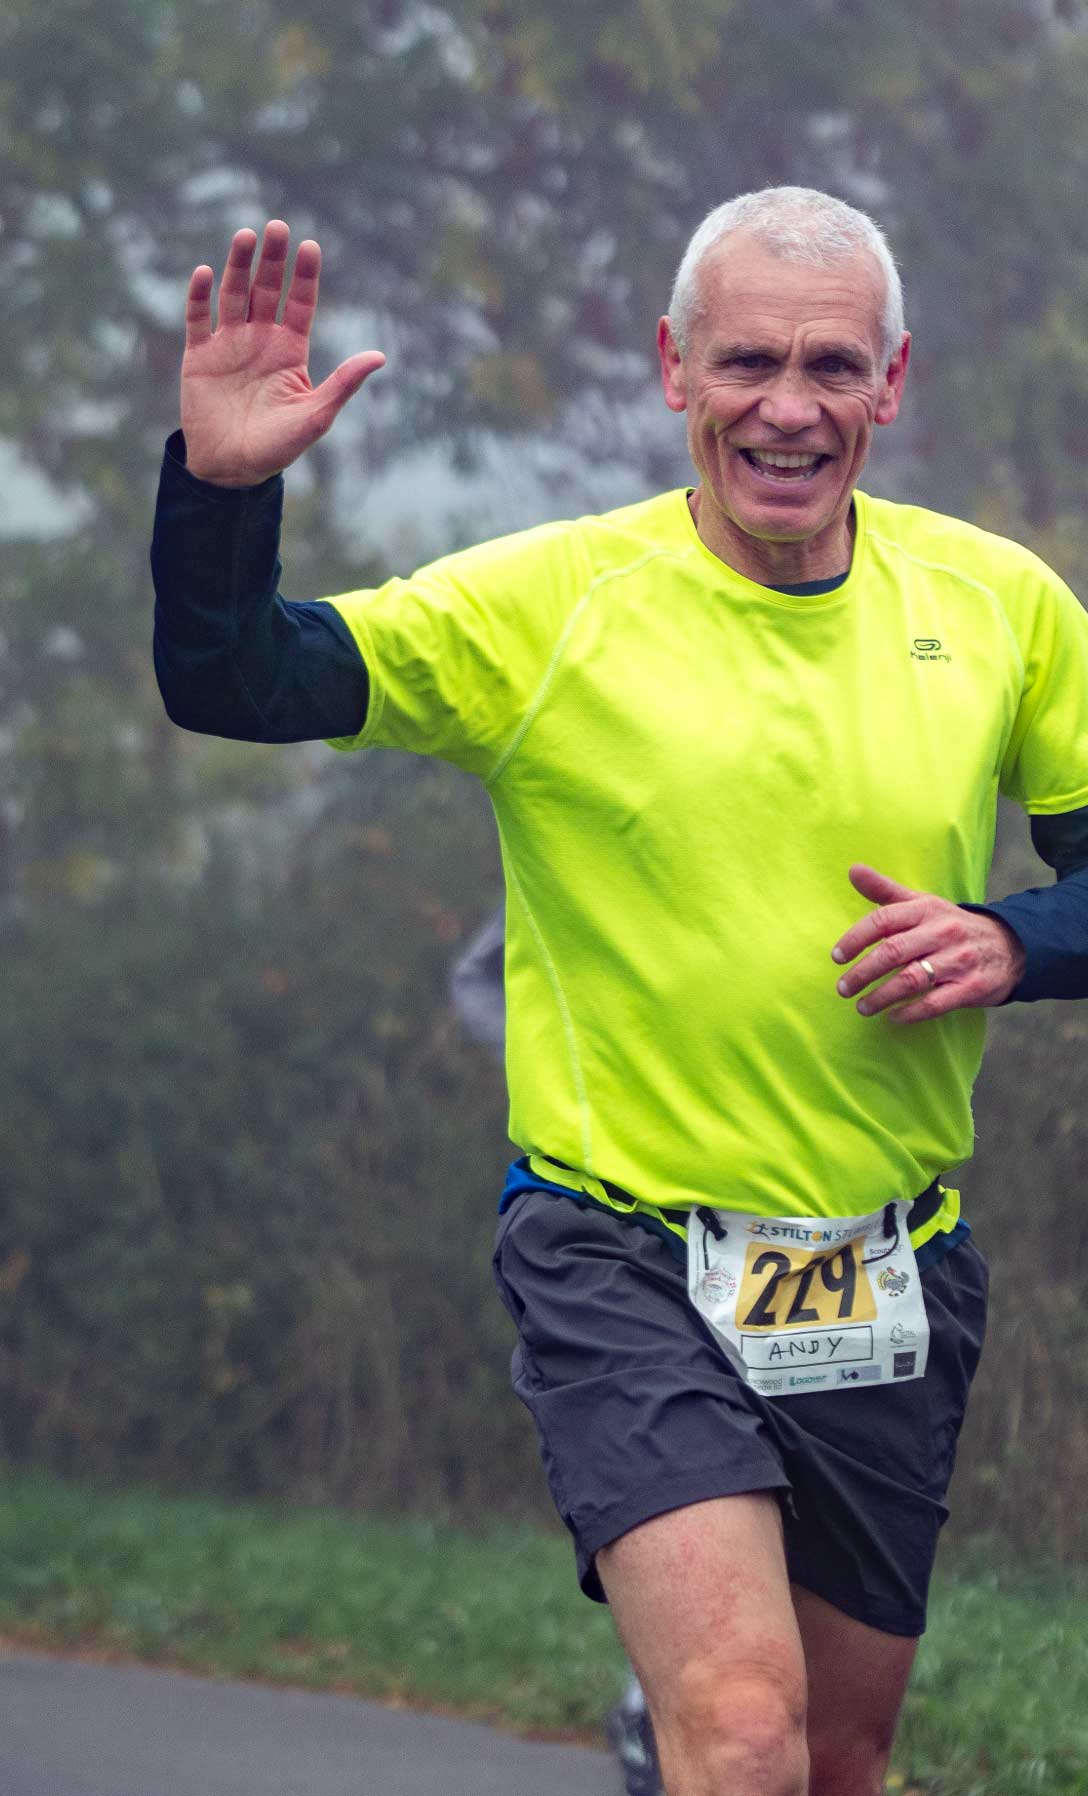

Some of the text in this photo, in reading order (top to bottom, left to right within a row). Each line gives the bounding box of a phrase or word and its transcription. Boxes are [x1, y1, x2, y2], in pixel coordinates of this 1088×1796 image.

[770, 1225, 833, 1243] STILTON
[743, 1244, 857, 1326] 229
[768, 1336, 843, 1361] ANDY
